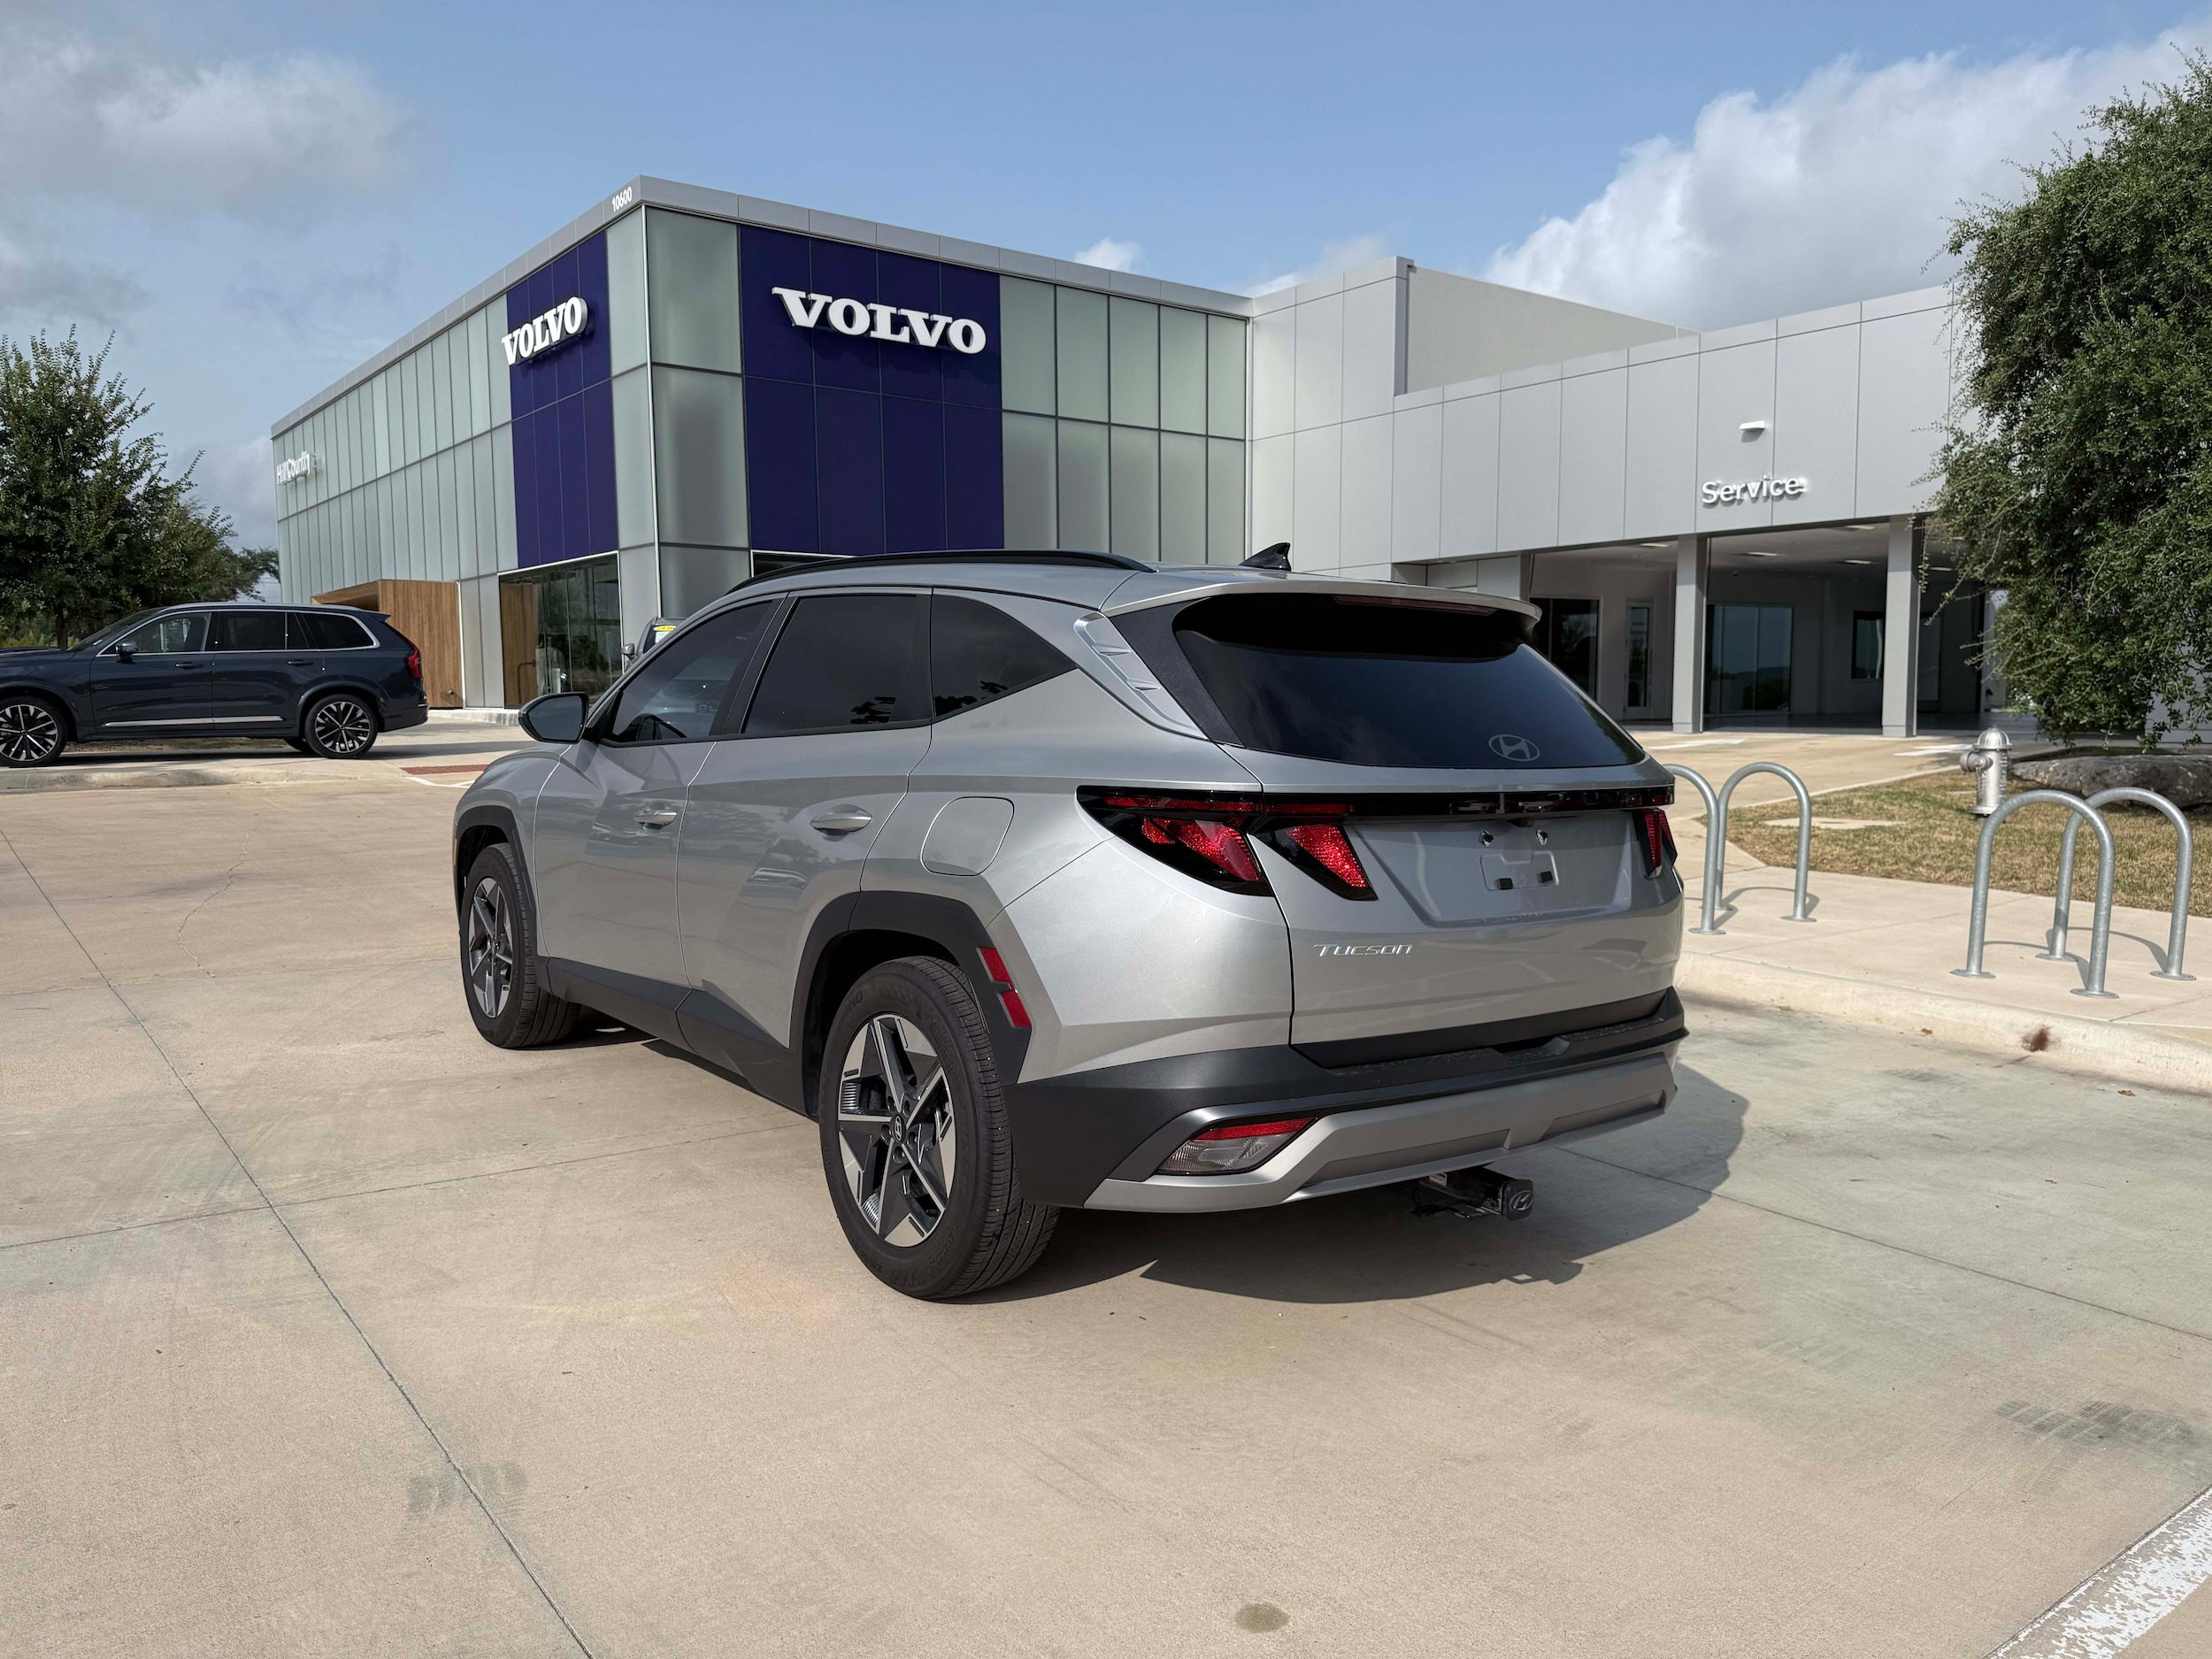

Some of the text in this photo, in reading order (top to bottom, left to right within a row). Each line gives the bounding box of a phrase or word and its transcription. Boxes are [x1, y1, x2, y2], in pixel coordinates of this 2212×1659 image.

[611, 186, 633, 212] 10600
[501, 296, 588, 365] VOLVO
[772, 286, 987, 354] VOLVO
[1701, 474, 1801, 504] Service
